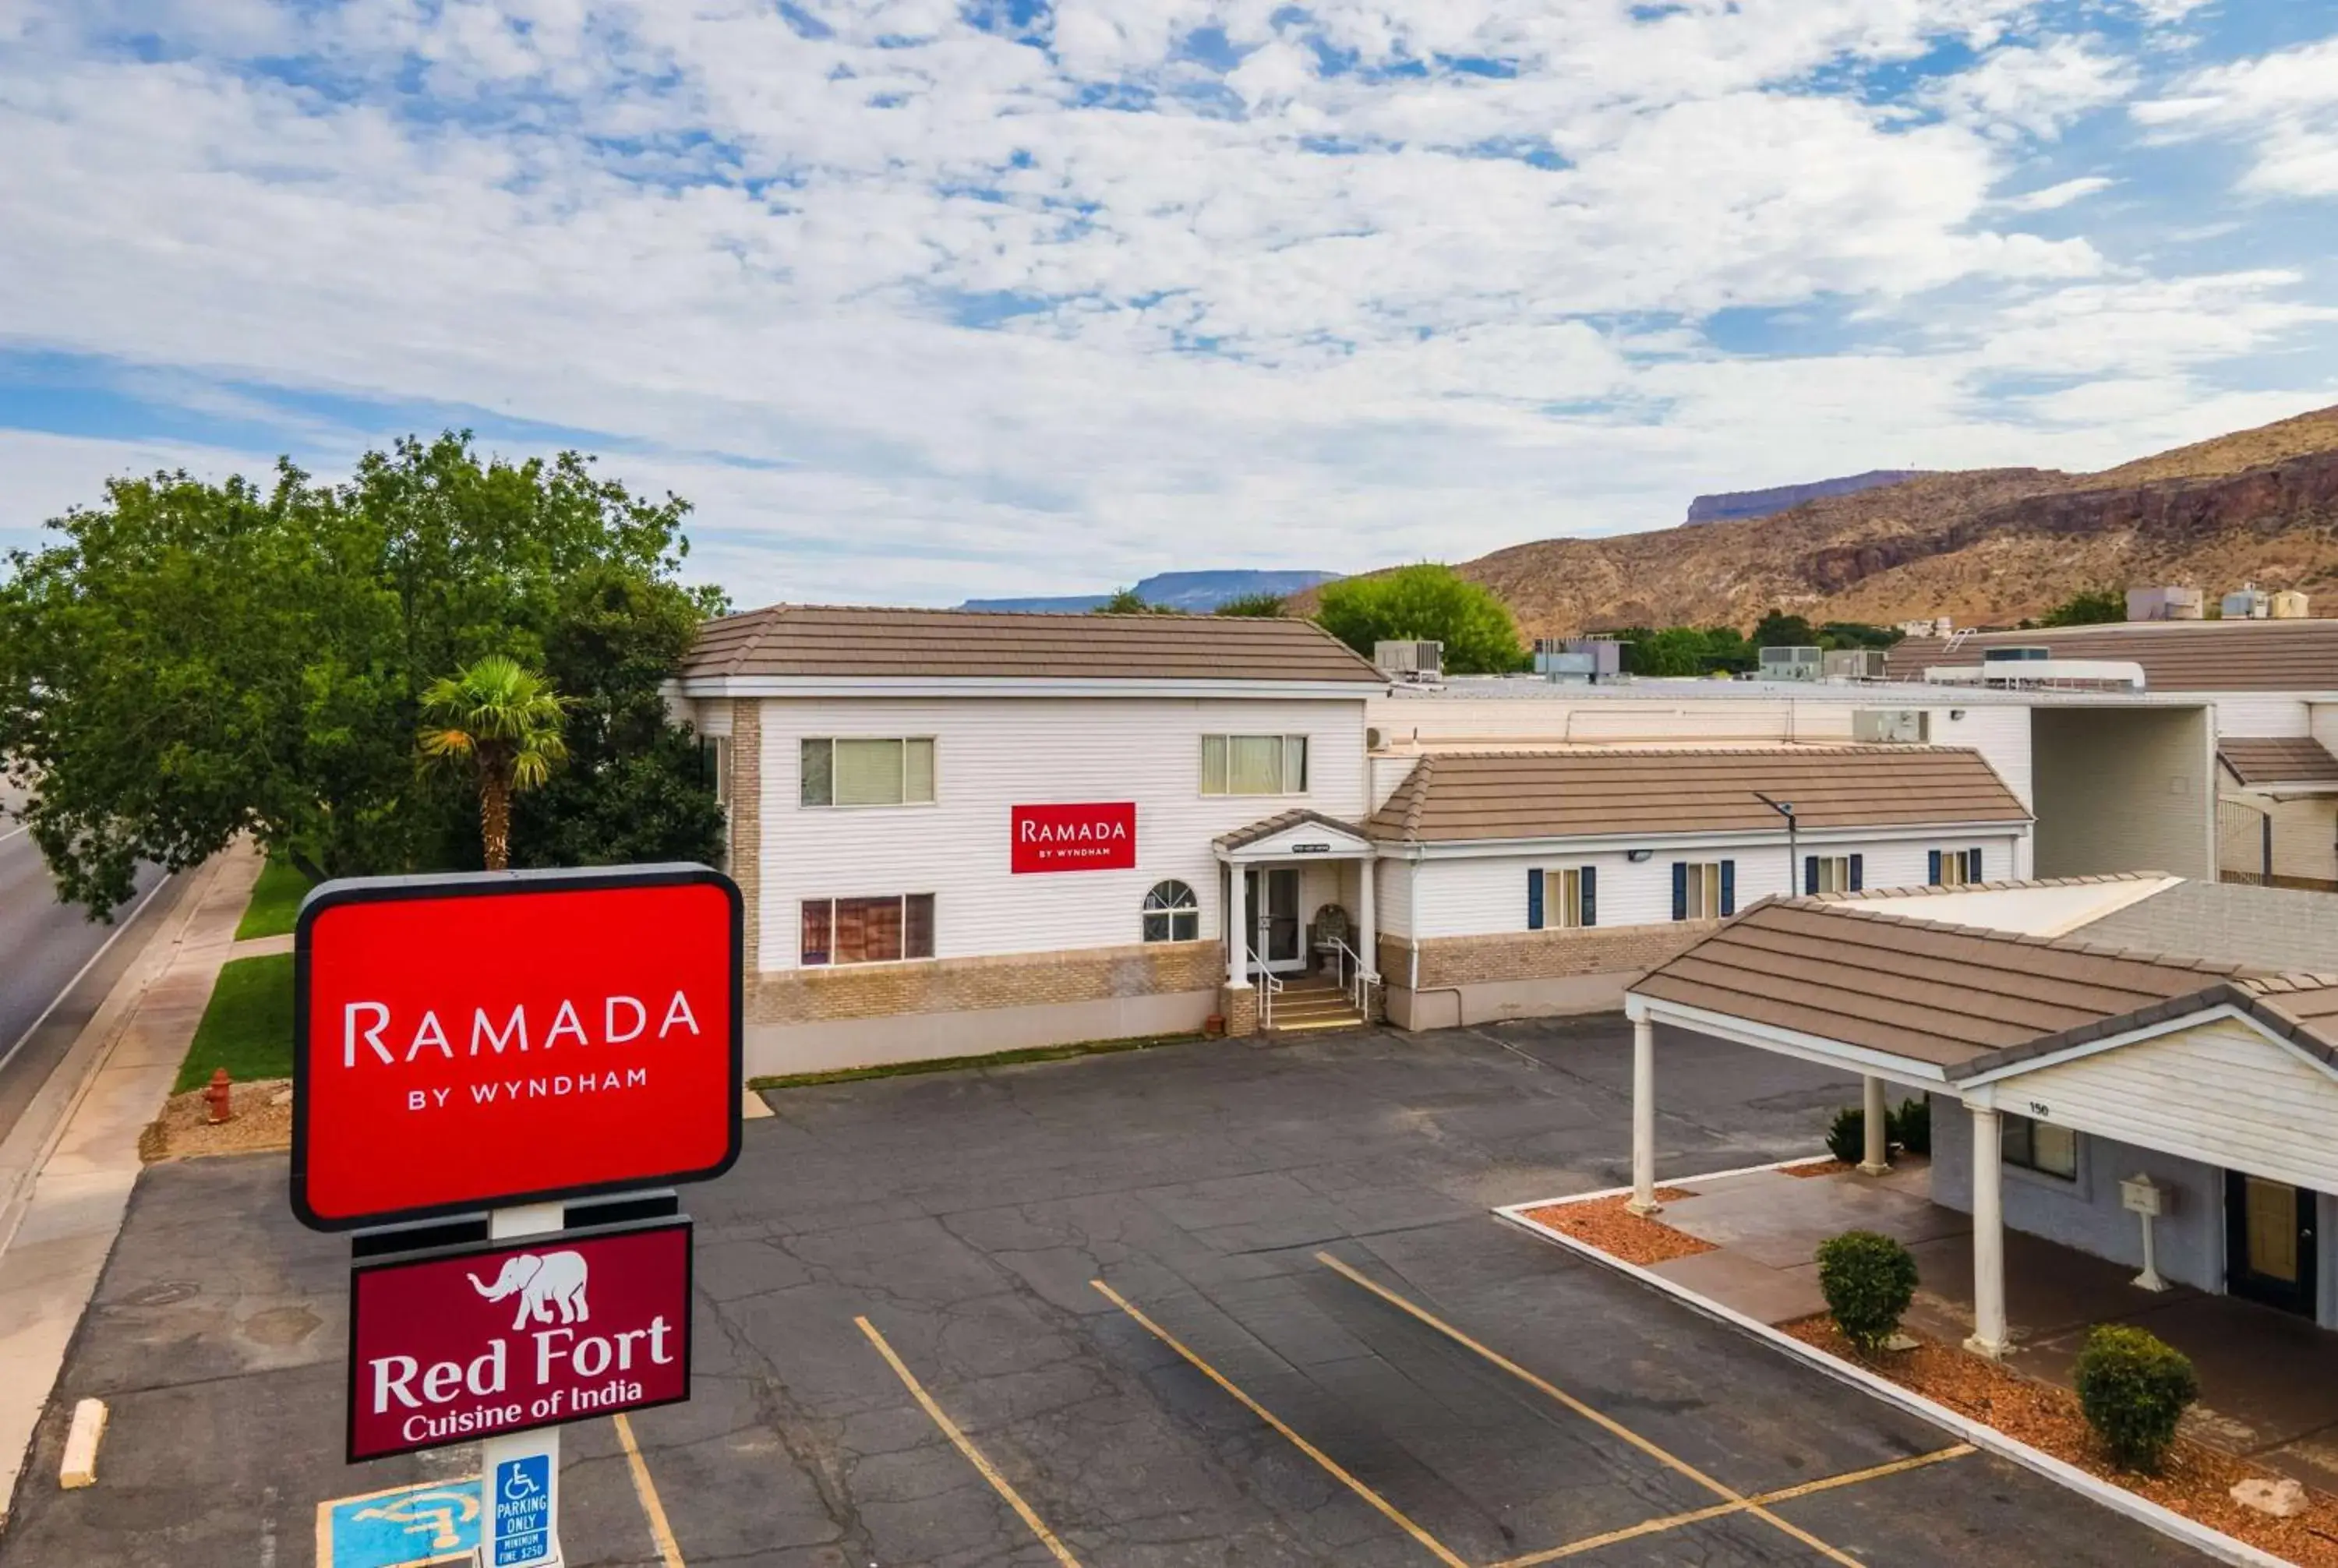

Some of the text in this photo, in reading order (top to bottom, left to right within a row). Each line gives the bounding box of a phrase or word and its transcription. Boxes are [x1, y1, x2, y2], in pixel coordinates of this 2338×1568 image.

[1022, 820, 1126, 842] RAMADA
[1057, 848, 1110, 857] WYNDHAM
[344, 991, 700, 1068] RAMADA
[408, 1068, 647, 1111] BY WYNDHAM
[2029, 1101, 2049, 1116] 150
[369, 1315, 673, 1414] Red Fort
[403, 1380, 642, 1442] Cuisine of India
[498, 1495, 546, 1518] PARKING
[507, 1513, 536, 1534] ONLY
[504, 1534, 539, 1549] MINIMUM
[521, 1545, 543, 1559] $250
